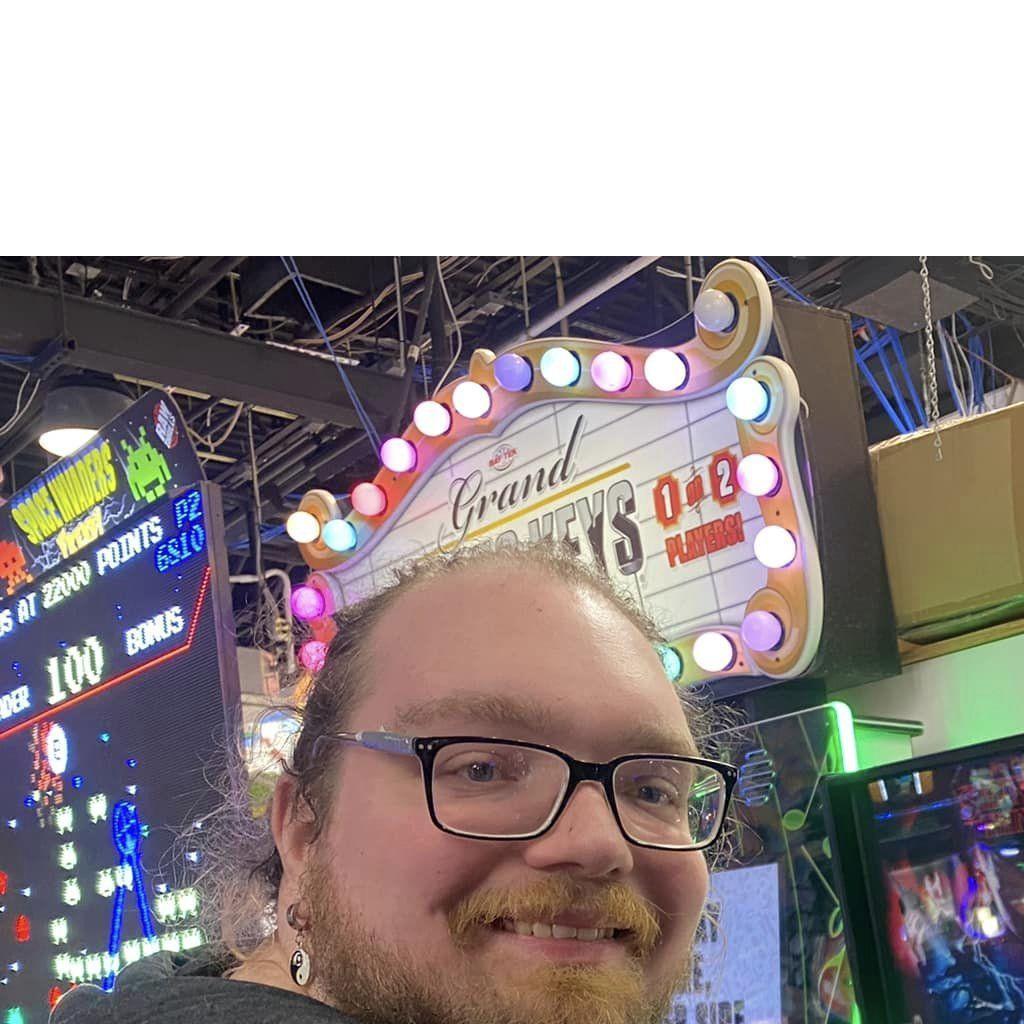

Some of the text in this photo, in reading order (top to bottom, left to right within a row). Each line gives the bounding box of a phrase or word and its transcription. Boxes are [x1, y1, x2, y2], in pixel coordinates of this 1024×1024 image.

[11, 441, 118, 545] SPACE INVADERS
[175, 491, 202, 528] P2
[438, 414, 584, 558] Grand
[526, 479, 645, 578] EYS
[17, 592, 37, 625] AT
[95, 515, 165, 576] POINTS
[664, 511, 745, 568] PLAYERS!
[46, 635, 105, 705] 100
[124, 605, 186, 656] BONUS
